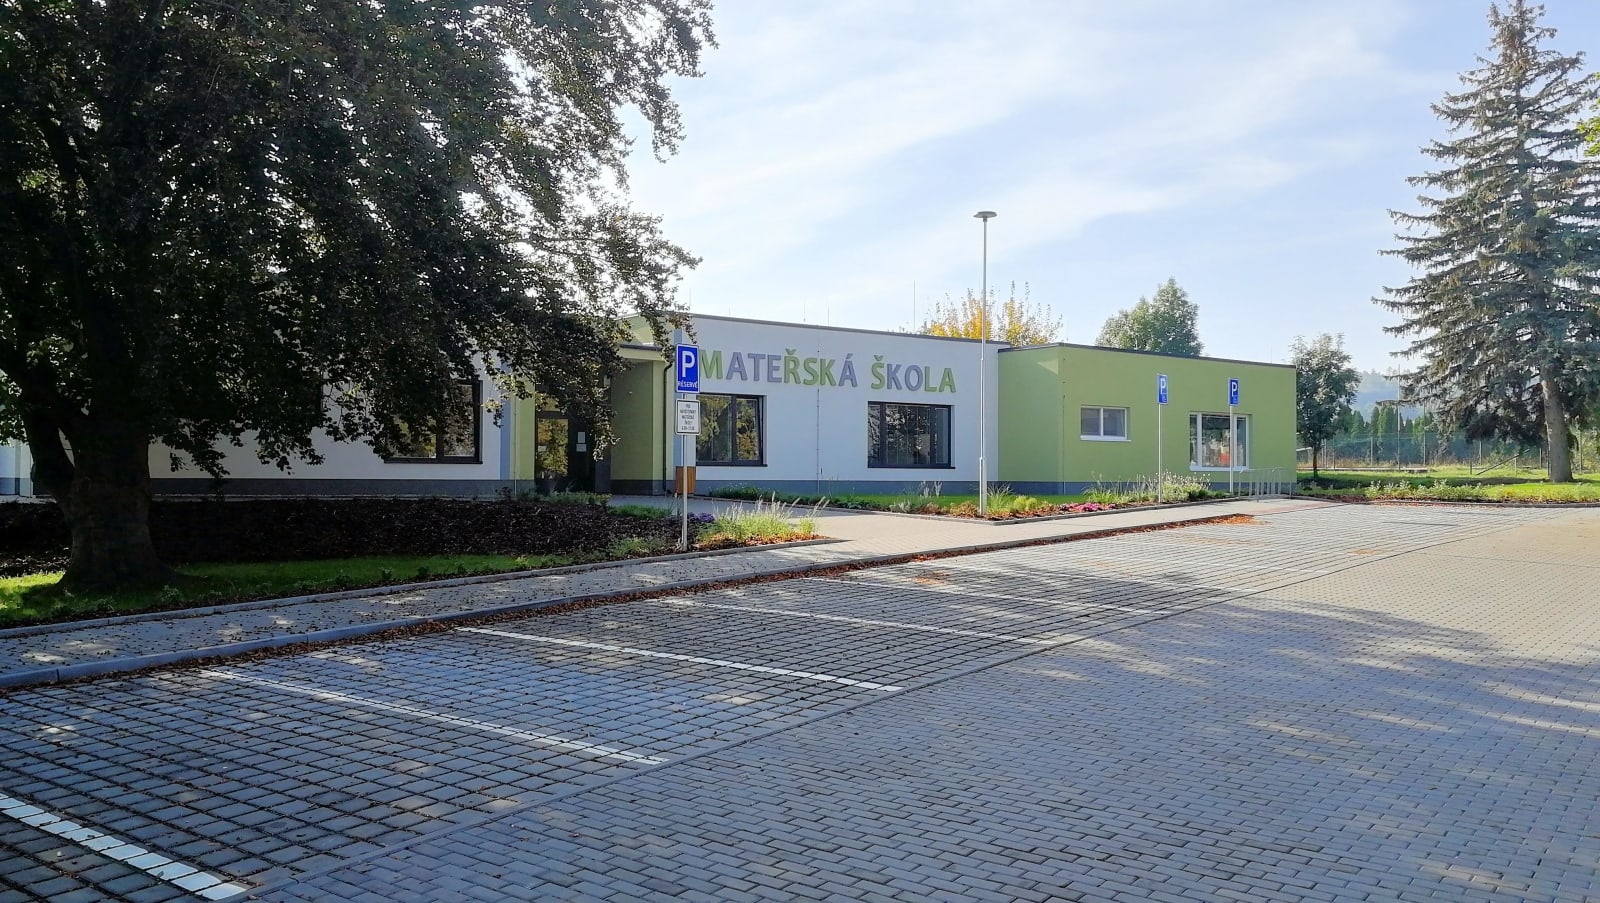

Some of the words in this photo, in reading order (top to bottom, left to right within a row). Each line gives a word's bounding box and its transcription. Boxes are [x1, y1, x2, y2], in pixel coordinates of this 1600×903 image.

[682, 350, 695, 378] P
[699, 349, 858, 388] MATEŘSKÁ
[871, 355, 957, 393] ŠKOLA
[1160, 378, 1166, 394] P
[1231, 382, 1237, 397] P
